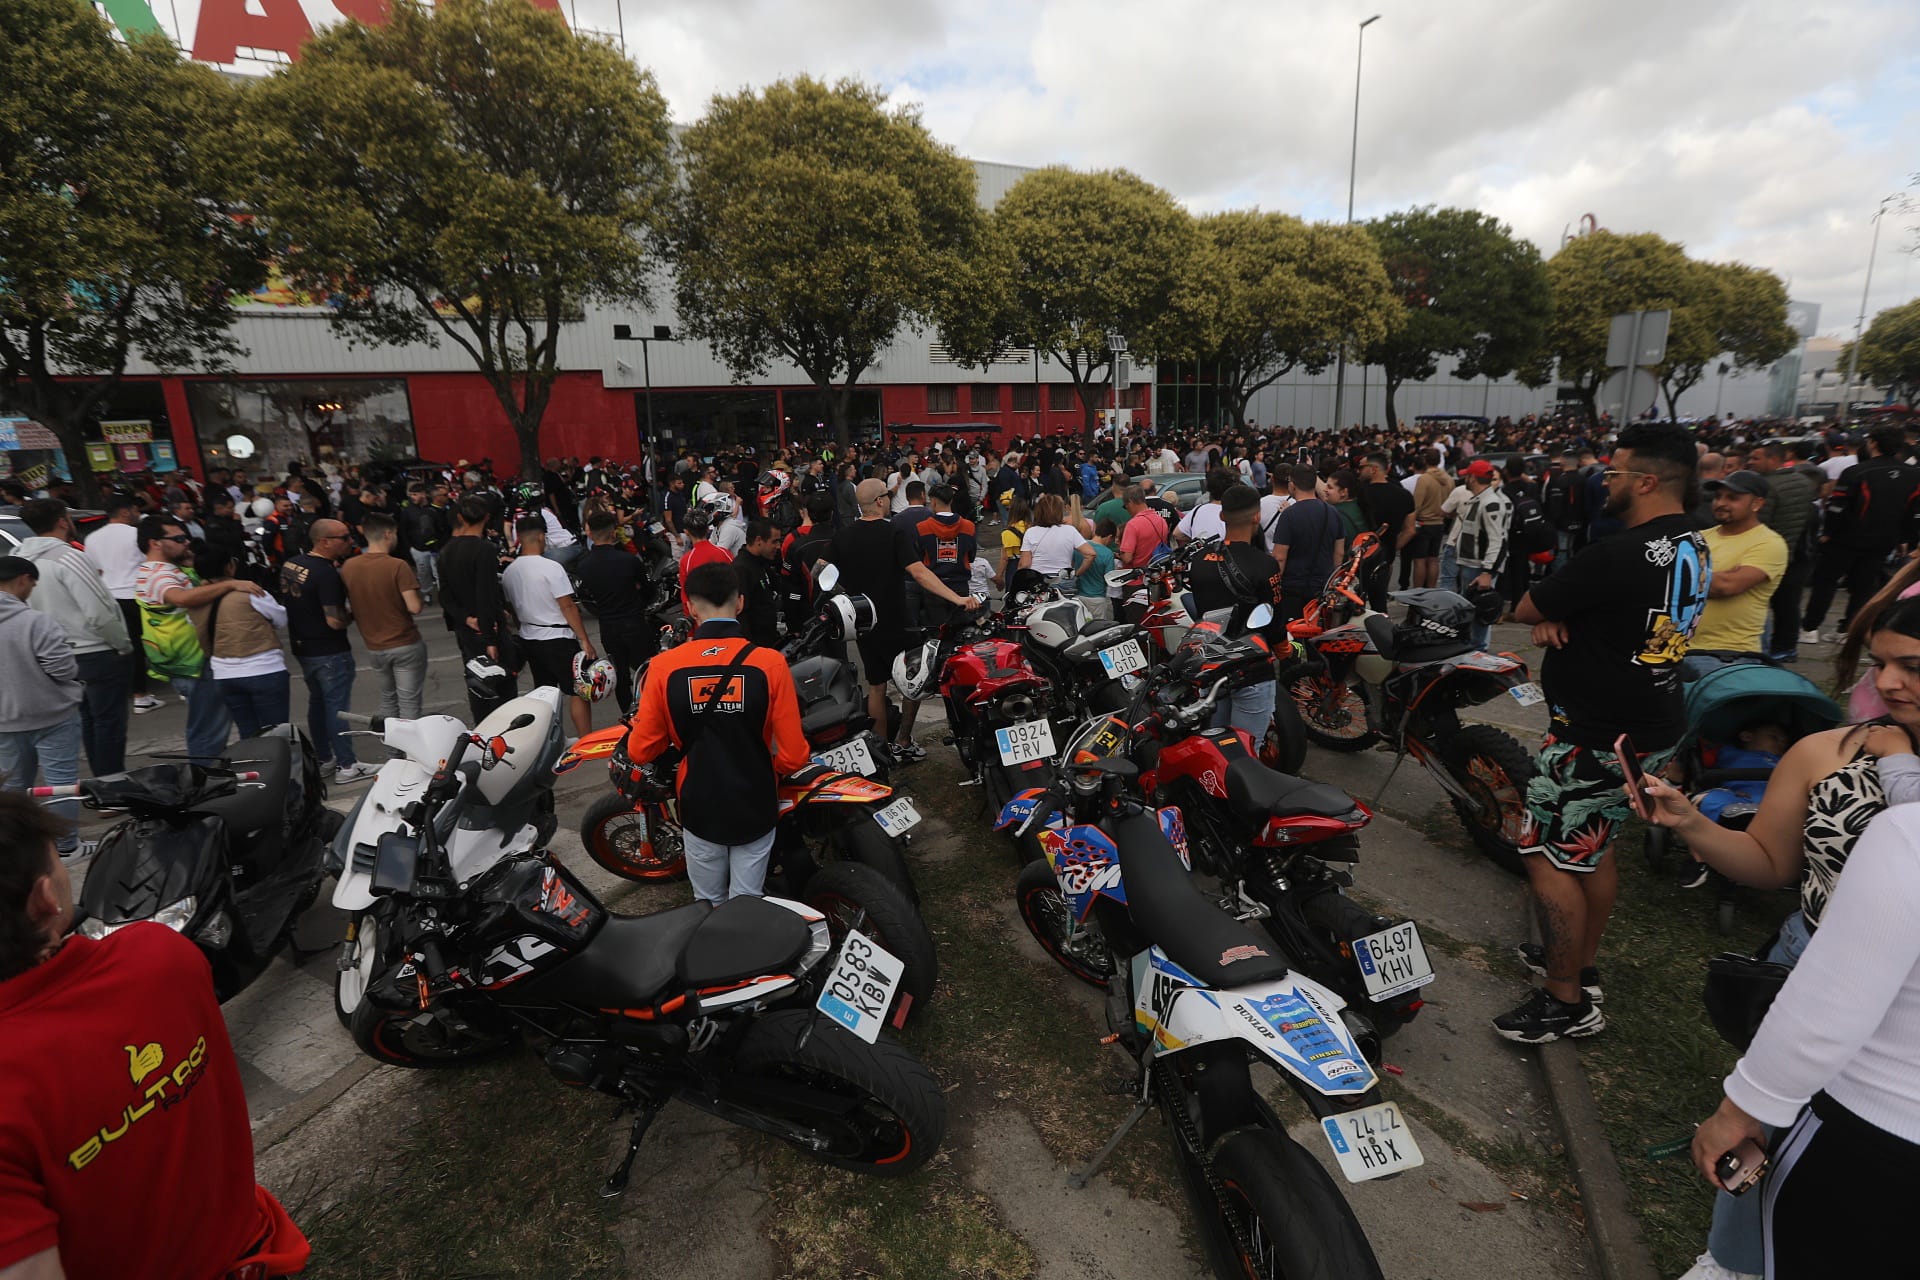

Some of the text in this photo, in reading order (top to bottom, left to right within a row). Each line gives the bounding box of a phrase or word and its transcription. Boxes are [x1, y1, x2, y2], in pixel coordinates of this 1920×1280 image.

[1420, 618, 1459, 637] 100%
[1109, 641, 1138, 661] 7109
[1115, 656, 1138, 673] GTD
[723, 702, 742, 711] TEAM
[1008, 722, 1048, 744] 0924
[826, 742, 865, 768] 2315
[1012, 740, 1041, 761] FRV
[886, 802, 909, 820] 0610
[892, 815, 913, 831] LDK
[1057, 859, 1122, 895] KTM
[1369, 927, 1412, 960] 6497
[832, 938, 872, 1002] 0583
[1378, 954, 1413, 985] KHV
[856, 965, 892, 1020] KBW
[843, 1010, 854, 1022] E
[1232, 1003, 1276, 1040] DUNLOP
[68, 1035, 206, 1171] BULTACO
[1349, 1107, 1401, 1140] 2422
[1357, 1138, 1403, 1169] HBX
